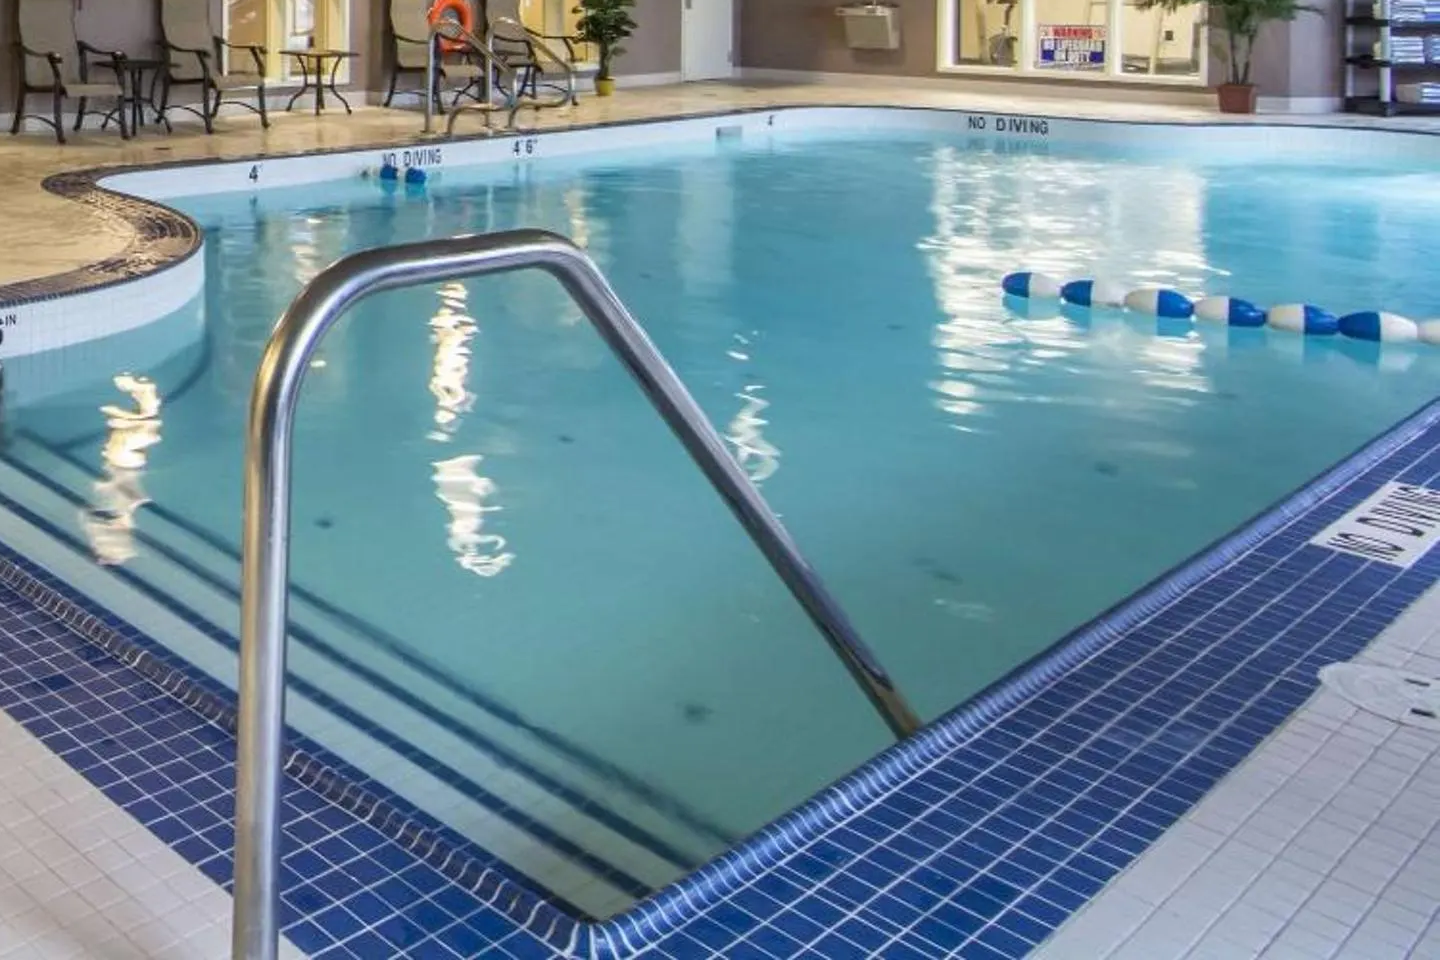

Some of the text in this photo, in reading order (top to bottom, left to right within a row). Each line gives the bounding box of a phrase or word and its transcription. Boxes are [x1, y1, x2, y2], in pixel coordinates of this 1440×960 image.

[968, 115, 1049, 136] NO DIVING
[403, 148, 442, 167] DIVING
[1326, 532, 1406, 561] NO
